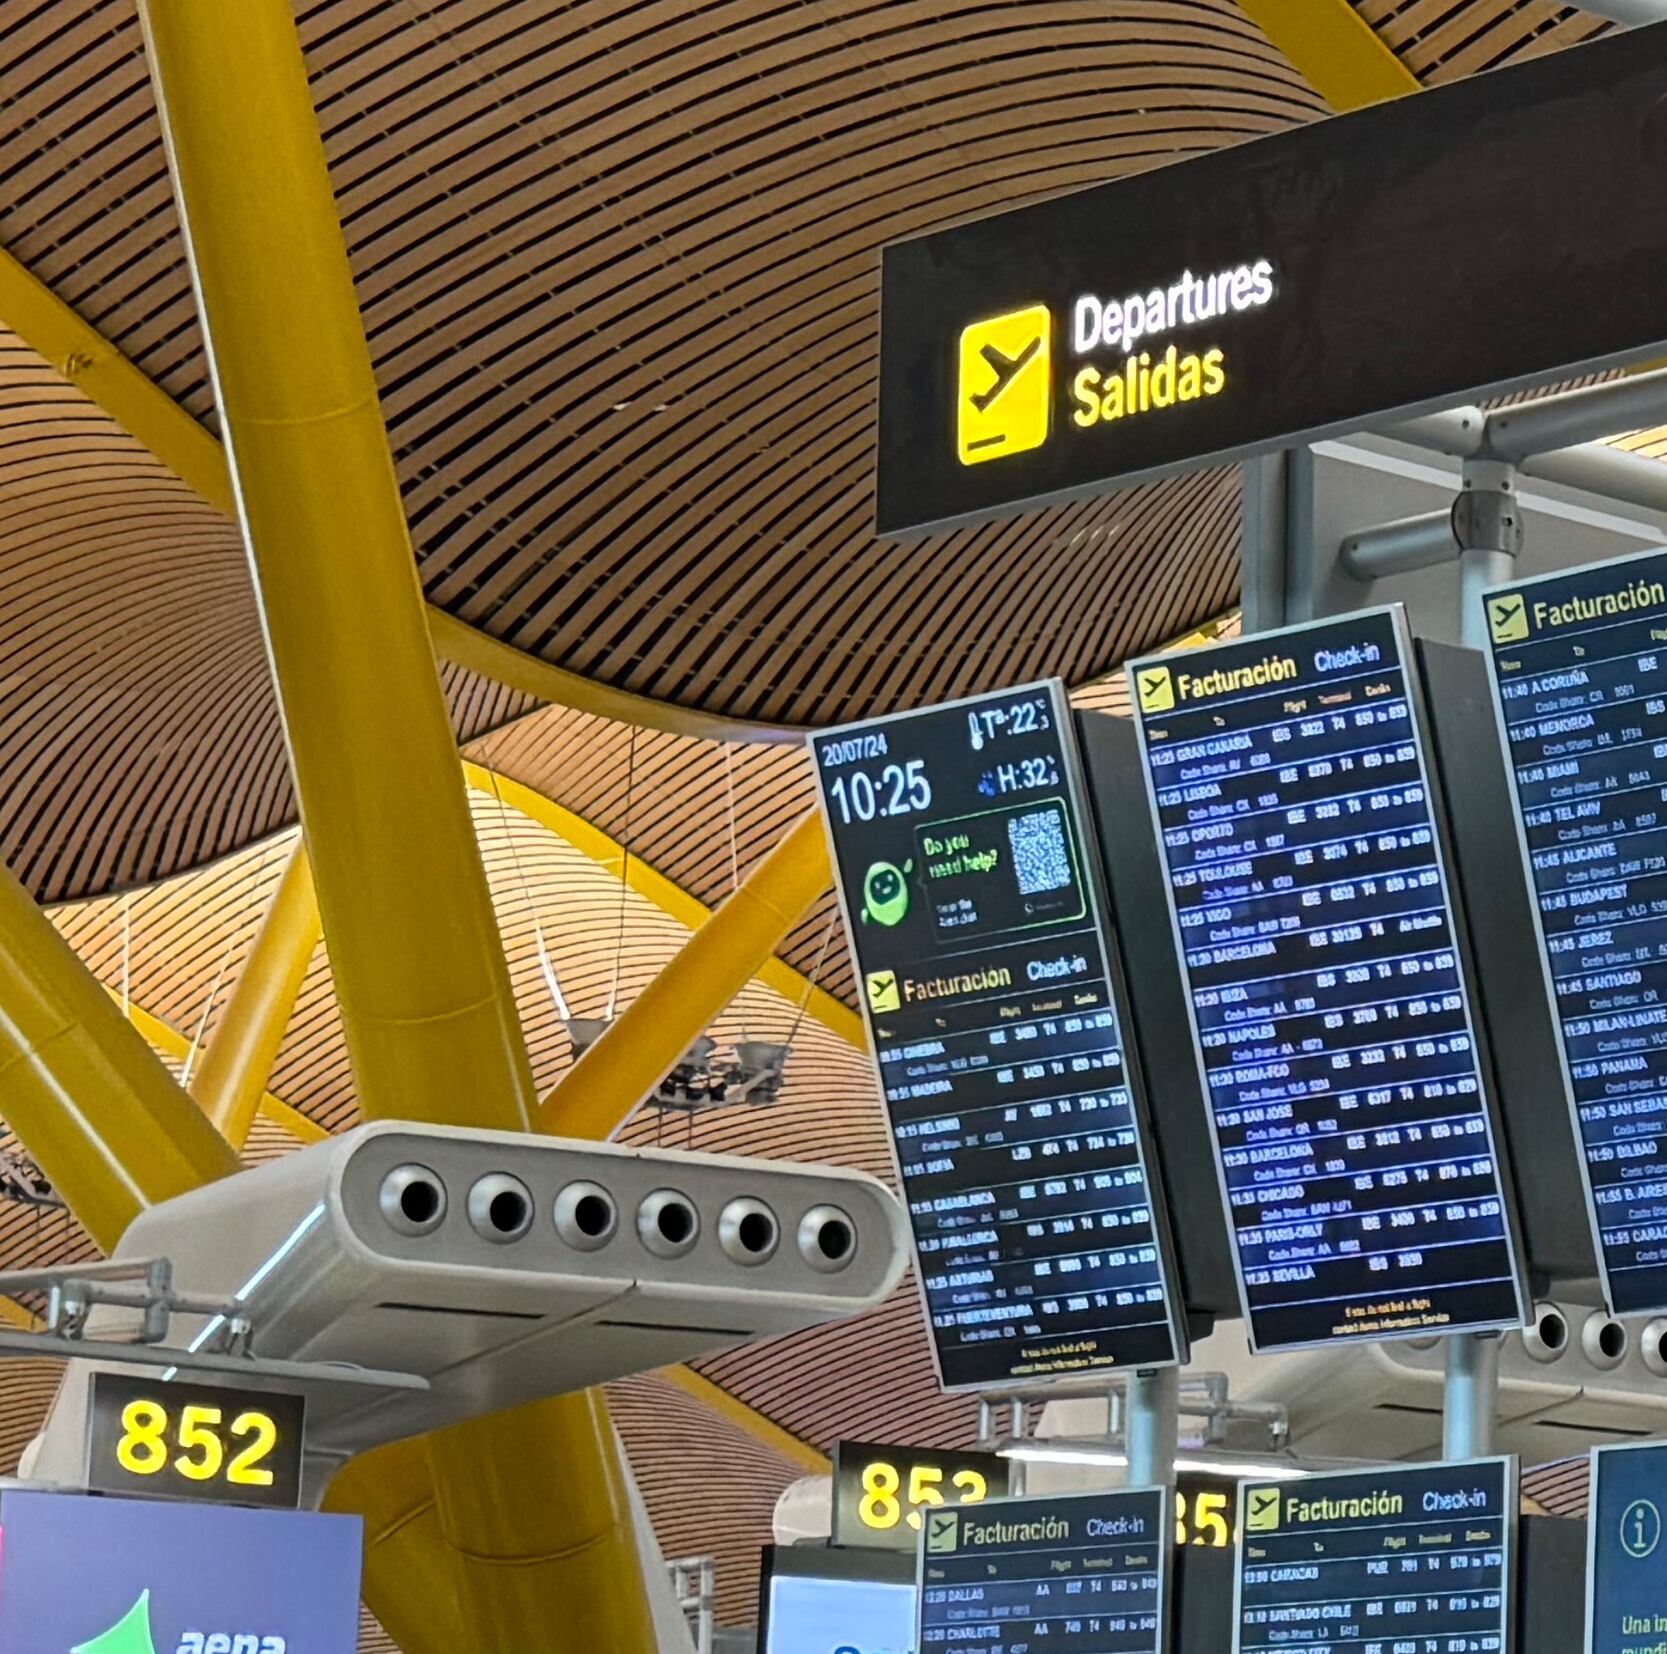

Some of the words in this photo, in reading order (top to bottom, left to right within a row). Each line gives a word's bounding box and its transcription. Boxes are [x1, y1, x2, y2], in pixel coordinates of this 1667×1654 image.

[1074, 259, 1274, 354] Departures
[1073, 345, 1226, 428] Salidas
[1534, 579, 1666, 629] Facturación
[1177, 655, 1297, 700] Facturación
[1314, 642, 1381, 673] Check-in
[822, 732, 888, 767] 20/07/24
[831, 759, 932, 824] 10:25
[923, 837, 944, 856] Do
[903, 966, 1012, 1002] Facturación
[1026, 954, 1087, 981] Check-in
[116, 1400, 277, 1486] 852
[1286, 1490, 1402, 1523] Facturación
[1422, 1488, 1486, 1512] Check-in
[963, 1516, 1069, 1546] Facturación
[1086, 1516, 1145, 1537] Check-in
[1622, 1615, 1651, 1635] Una
